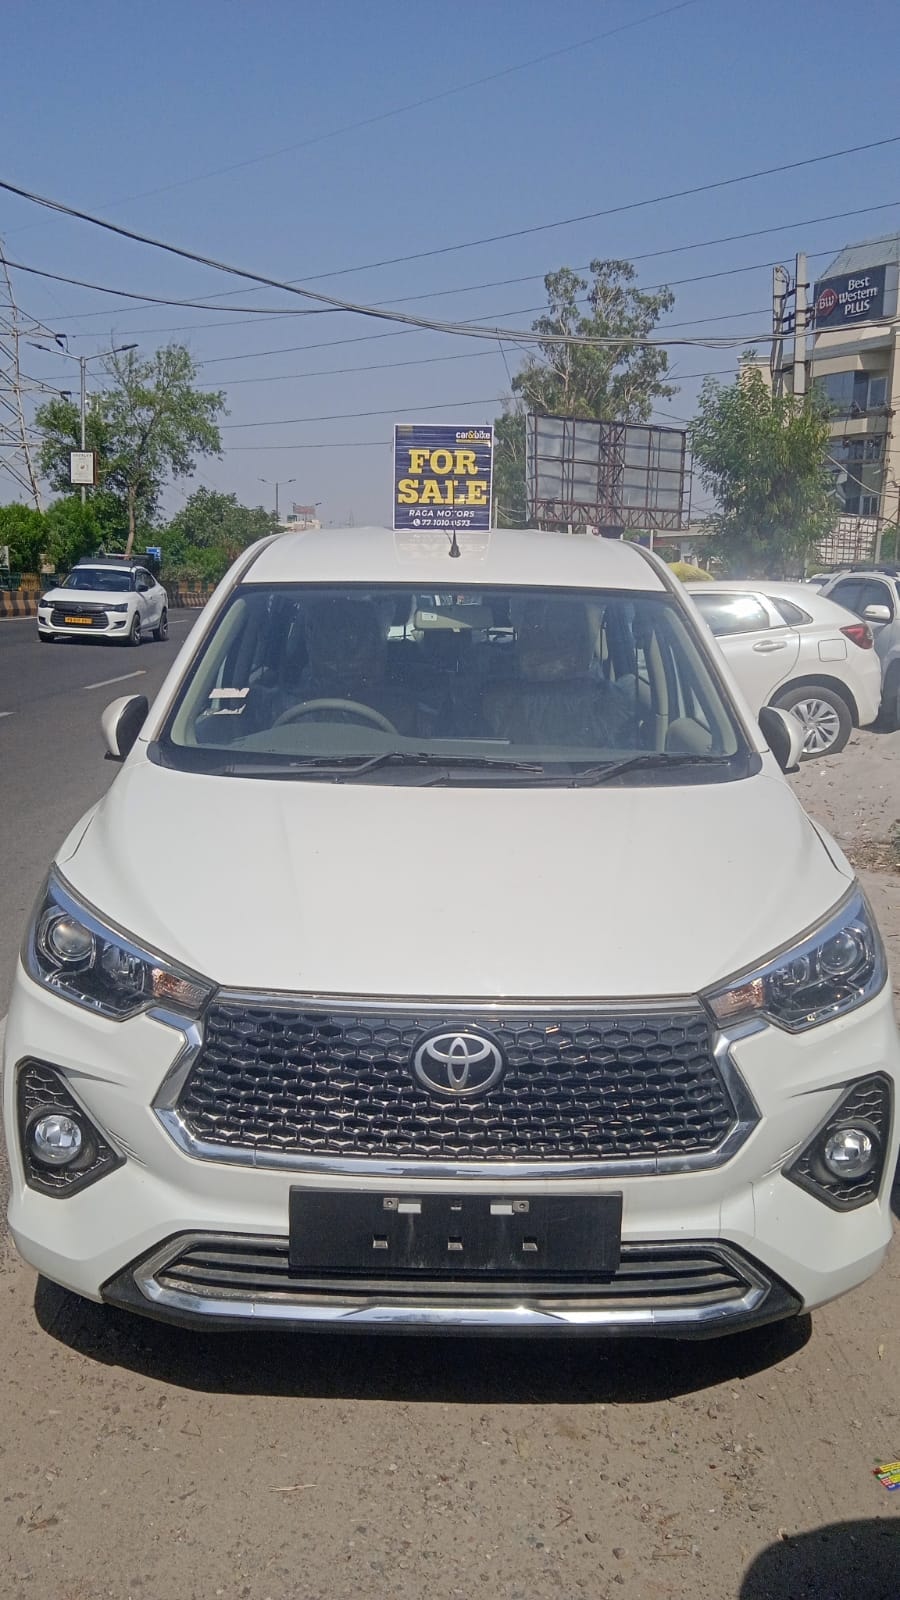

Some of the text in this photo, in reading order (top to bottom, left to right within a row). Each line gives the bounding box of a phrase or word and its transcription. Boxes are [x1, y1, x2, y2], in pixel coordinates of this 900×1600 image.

[848, 277, 871, 290] Best
[820, 295, 834, 309] BW
[839, 287, 878, 303] Western
[845, 300, 870, 315] PLUS
[456, 430, 490, 439] car&bike
[408, 449, 478, 475] FOR
[398, 479, 487, 505] SALE
[409, 509, 434, 517] RAGA
